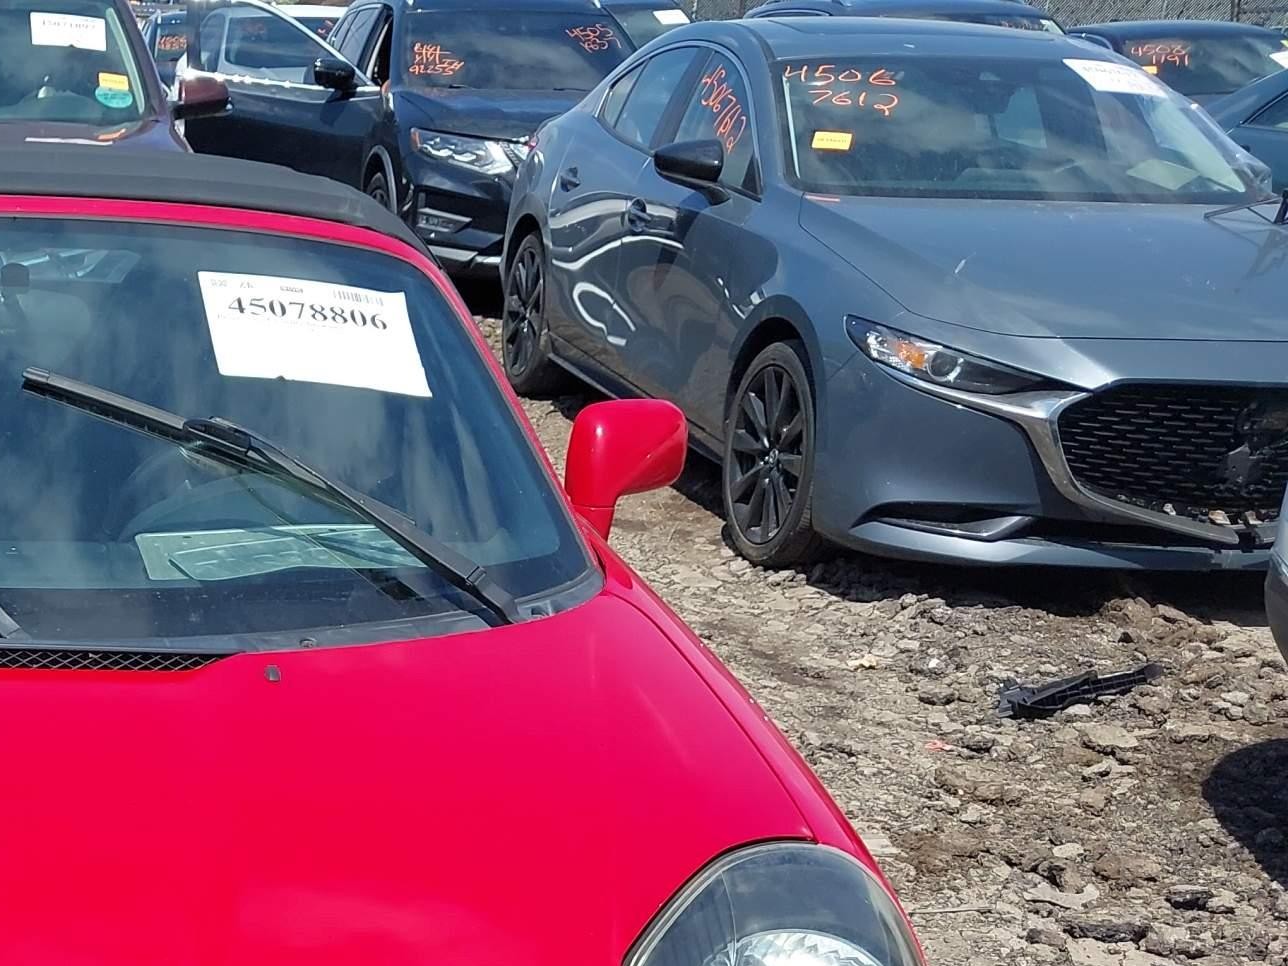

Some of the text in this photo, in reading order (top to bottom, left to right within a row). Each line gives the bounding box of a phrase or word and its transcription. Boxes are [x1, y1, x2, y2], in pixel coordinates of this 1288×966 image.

[565, 23, 614, 42] 4505
[784, 64, 897, 87] 4506
[808, 90, 899, 117] 7612
[227, 296, 388, 330] 45078806
